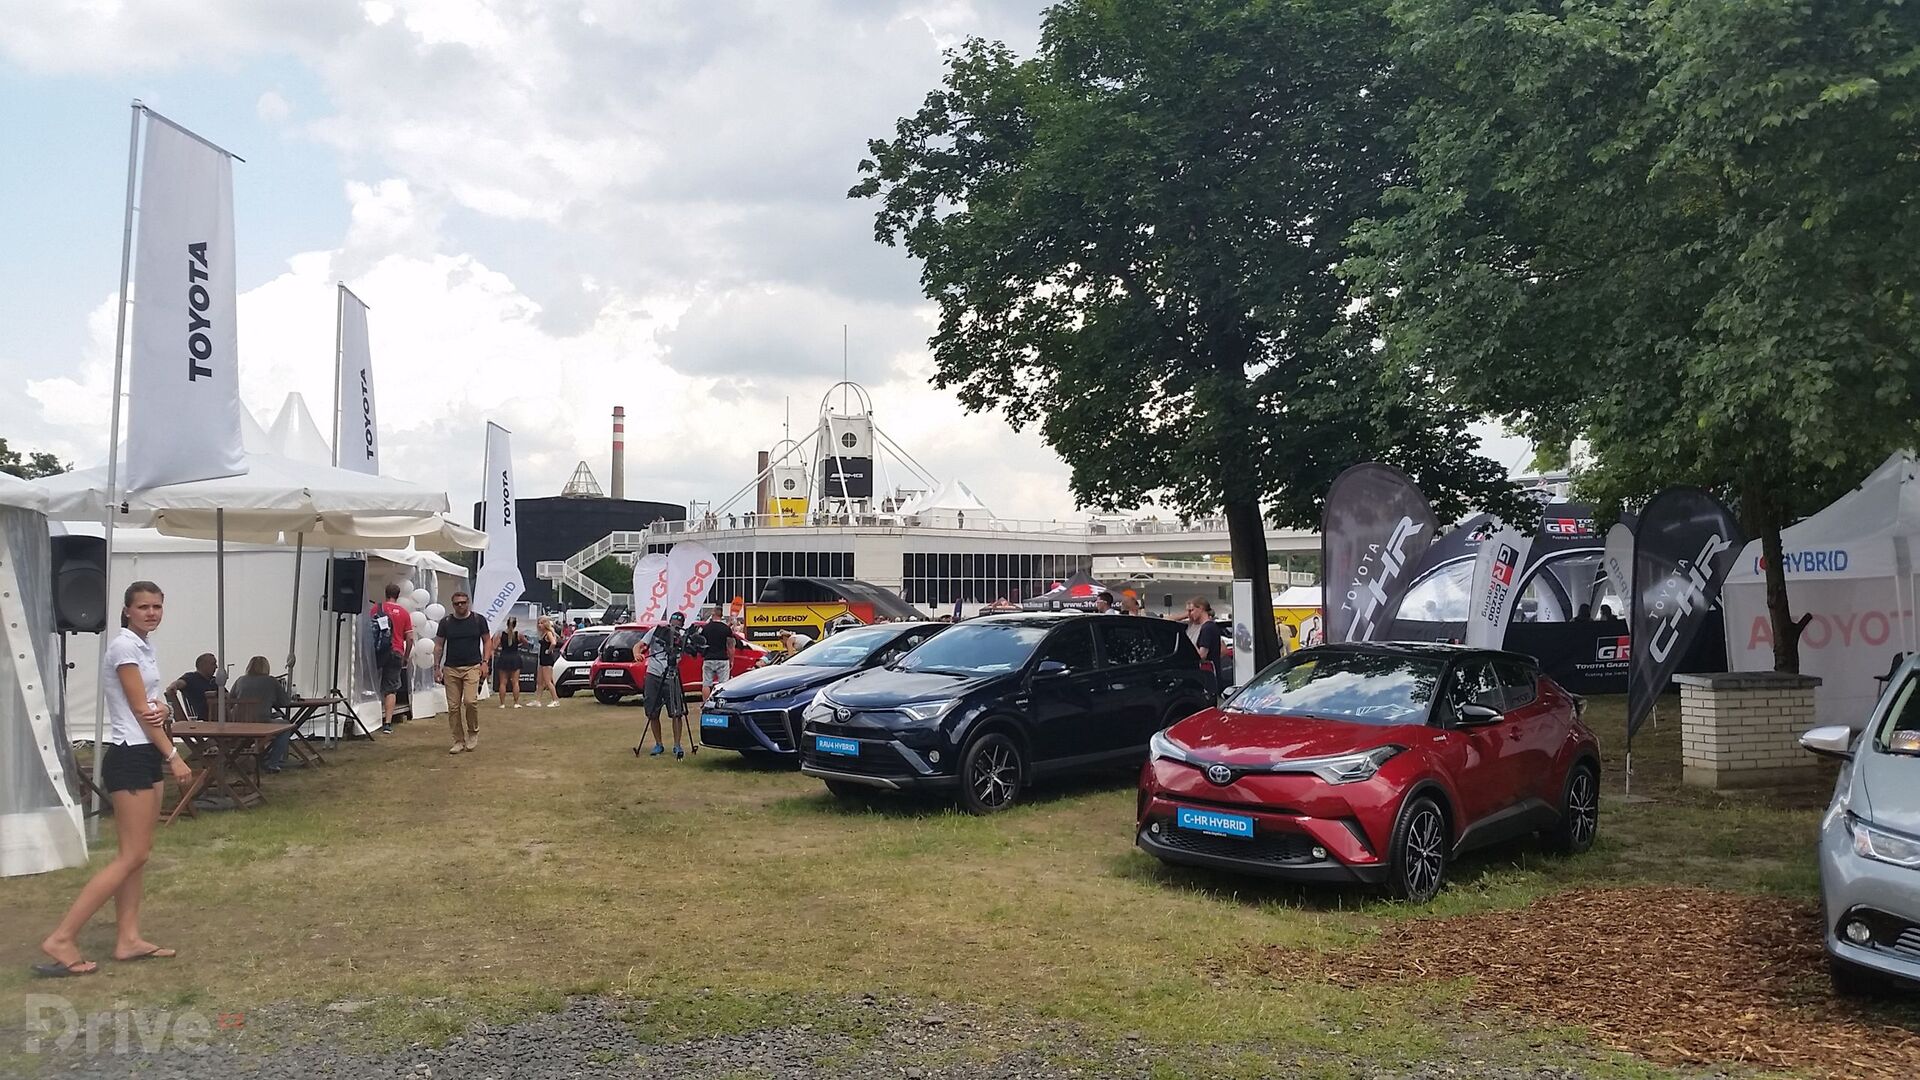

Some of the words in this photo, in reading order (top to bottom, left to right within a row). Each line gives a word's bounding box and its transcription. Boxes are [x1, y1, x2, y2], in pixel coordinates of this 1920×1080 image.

[188, 242, 212, 381] TOYOTA
[360, 369, 374, 460] TOYOTA
[502, 470, 511, 526] TOYOTA
[1546, 524, 1577, 534] GR
[1341, 543, 1380, 611] TOYOTA
[1493, 545, 1512, 581] GR
[485, 581, 516, 622] HYBRID
[679, 560, 713, 619] YGO
[1481, 580, 1496, 618] Racing
[1488, 583, 1502, 621] GAZOO
[1493, 588, 1509, 627] TOYOTA
[1649, 558, 1689, 620] TOYOTA
[1649, 534, 1732, 663] C-HR
[1598, 645, 1630, 660] GR
[819, 740, 834, 749] RAV4
[835, 742, 856, 751] HYBRID
[1183, 813, 1208, 825] C-HR
[1209, 817, 1247, 831] HYBRID
